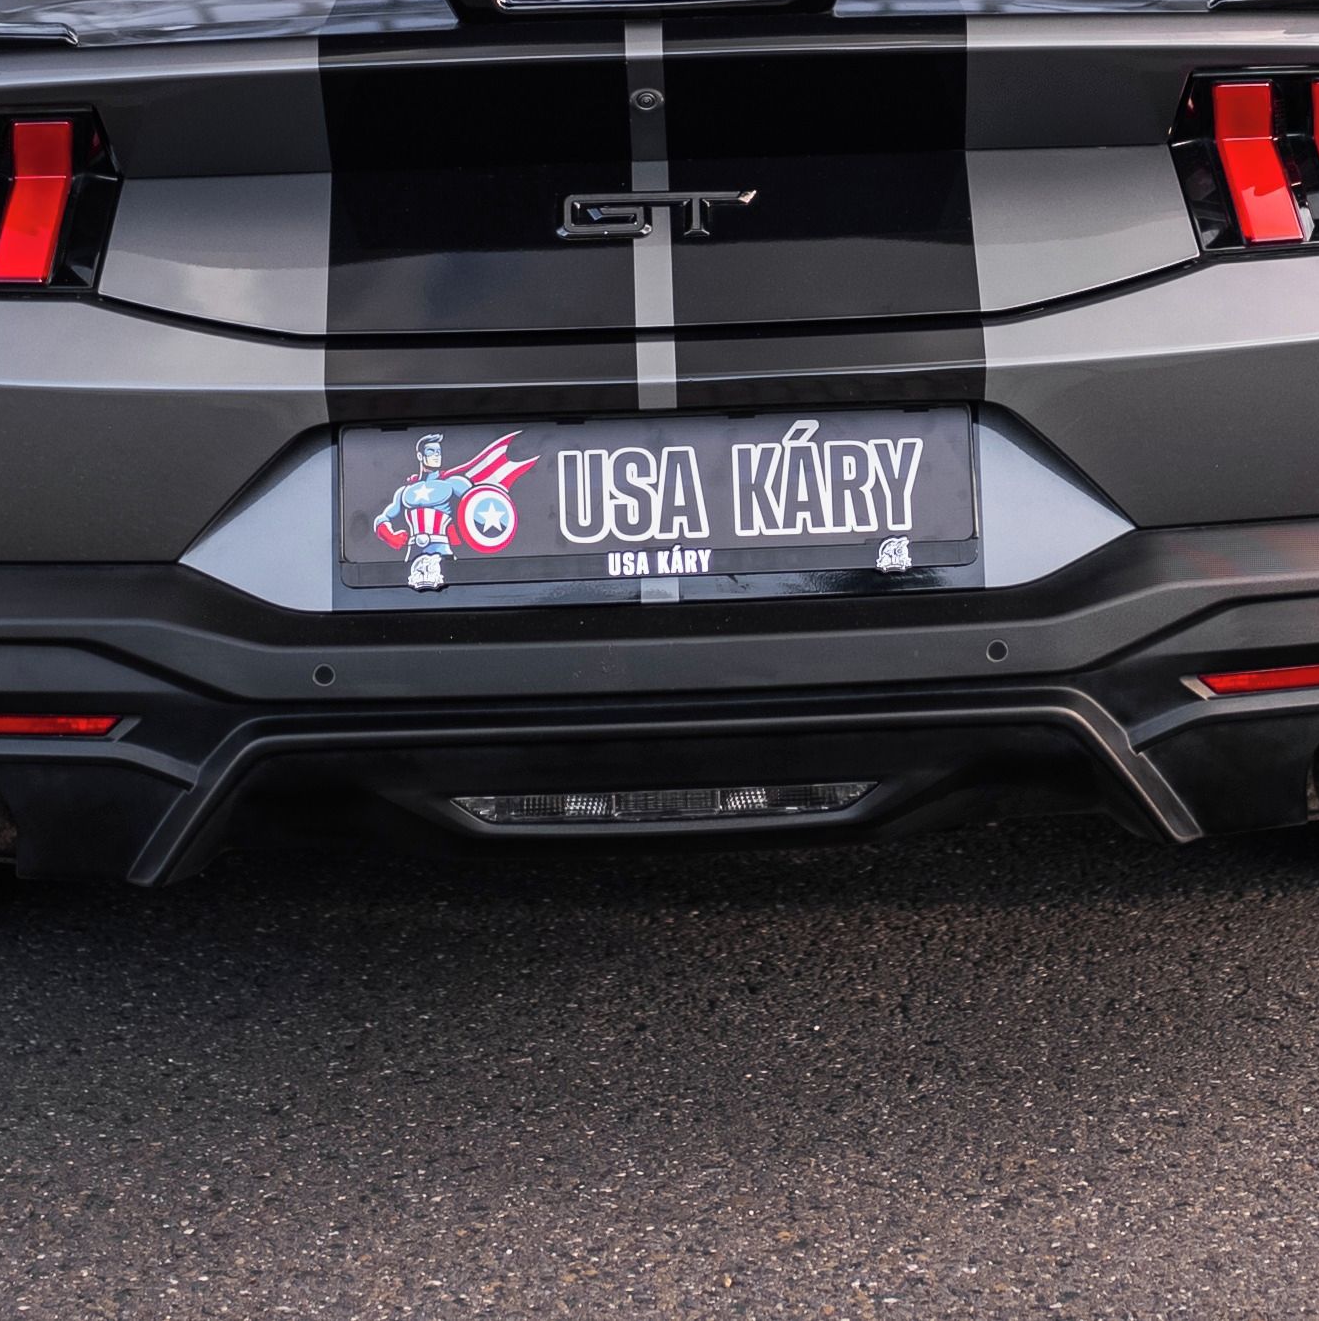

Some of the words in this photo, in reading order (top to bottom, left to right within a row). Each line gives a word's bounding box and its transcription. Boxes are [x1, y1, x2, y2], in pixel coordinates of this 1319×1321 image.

[556, 189, 757, 240] GT
[559, 446, 710, 543] USA
[732, 420, 923, 536] KÁRY
[608, 551, 650, 576] USA
[657, 545, 712, 574] KÁRY
